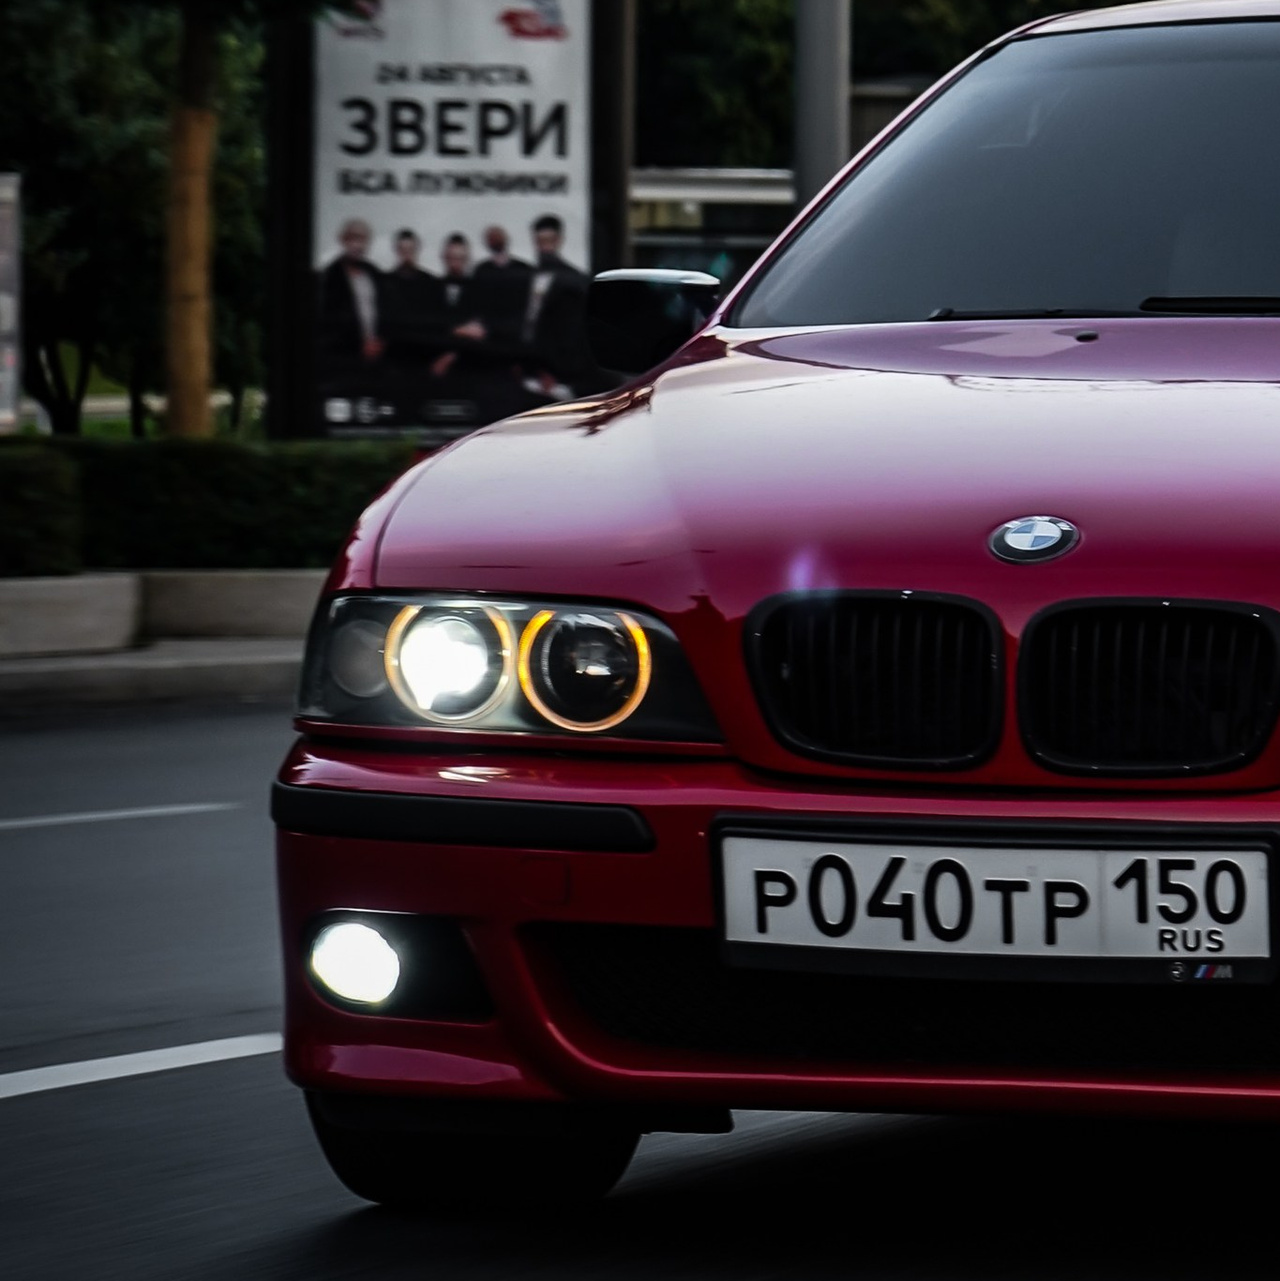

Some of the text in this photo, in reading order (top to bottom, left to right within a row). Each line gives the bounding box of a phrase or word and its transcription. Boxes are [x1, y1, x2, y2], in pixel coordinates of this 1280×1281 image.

[419, 63, 532, 86] АВГУСТА
[338, 98, 569, 158] ЗВЕРИ
[1112, 857, 1248, 925] 150
[1157, 927, 1226, 953] RUS
